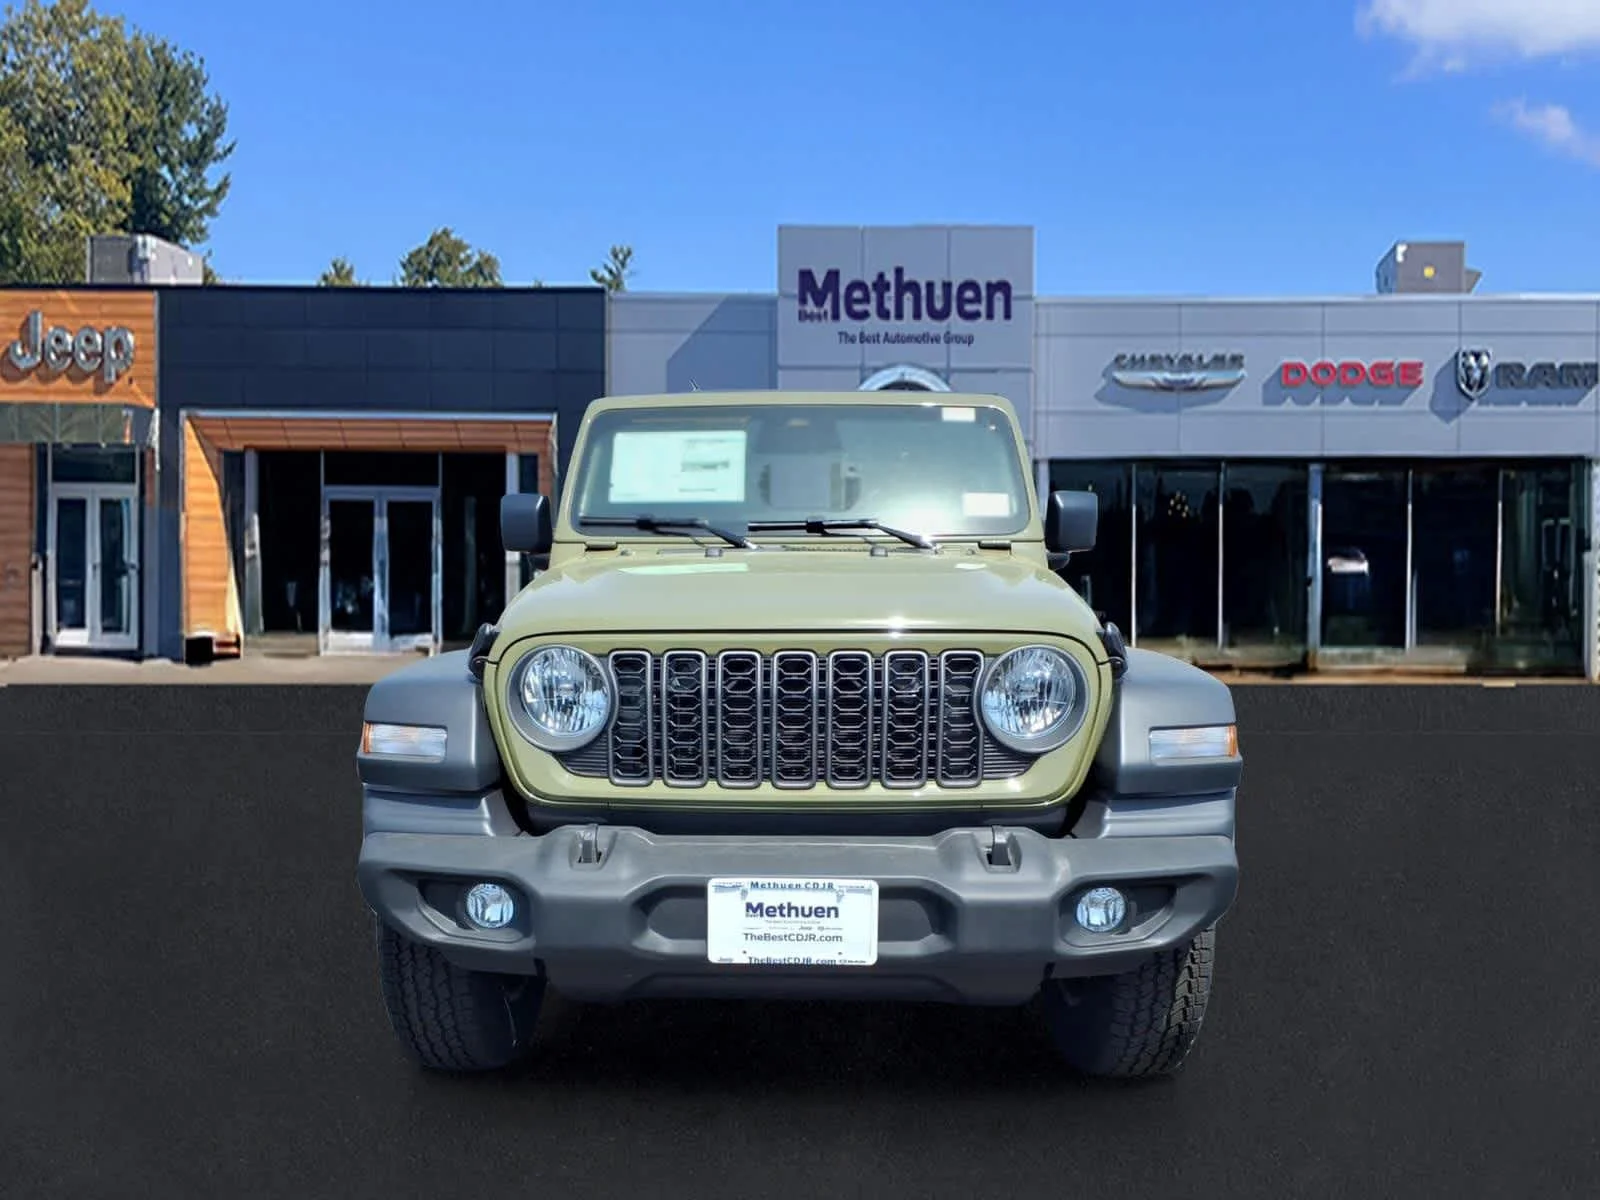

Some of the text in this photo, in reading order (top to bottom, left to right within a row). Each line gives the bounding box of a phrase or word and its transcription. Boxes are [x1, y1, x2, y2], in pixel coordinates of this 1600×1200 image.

[798, 267, 1012, 321] Methuen
[9, 310, 135, 383] Jeep
[838, 330, 974, 347] The Best Automotive Group
[1114, 353, 1245, 369] CHRYSLER
[1281, 361, 1424, 386] DODGE
[1495, 362, 1599, 390] RAM
[750, 880, 801, 889] Methuen
[804, 881, 835, 889] CDJR
[745, 901, 839, 918] Methuen
[744, 932, 843, 943] TheBestCDJR.com
